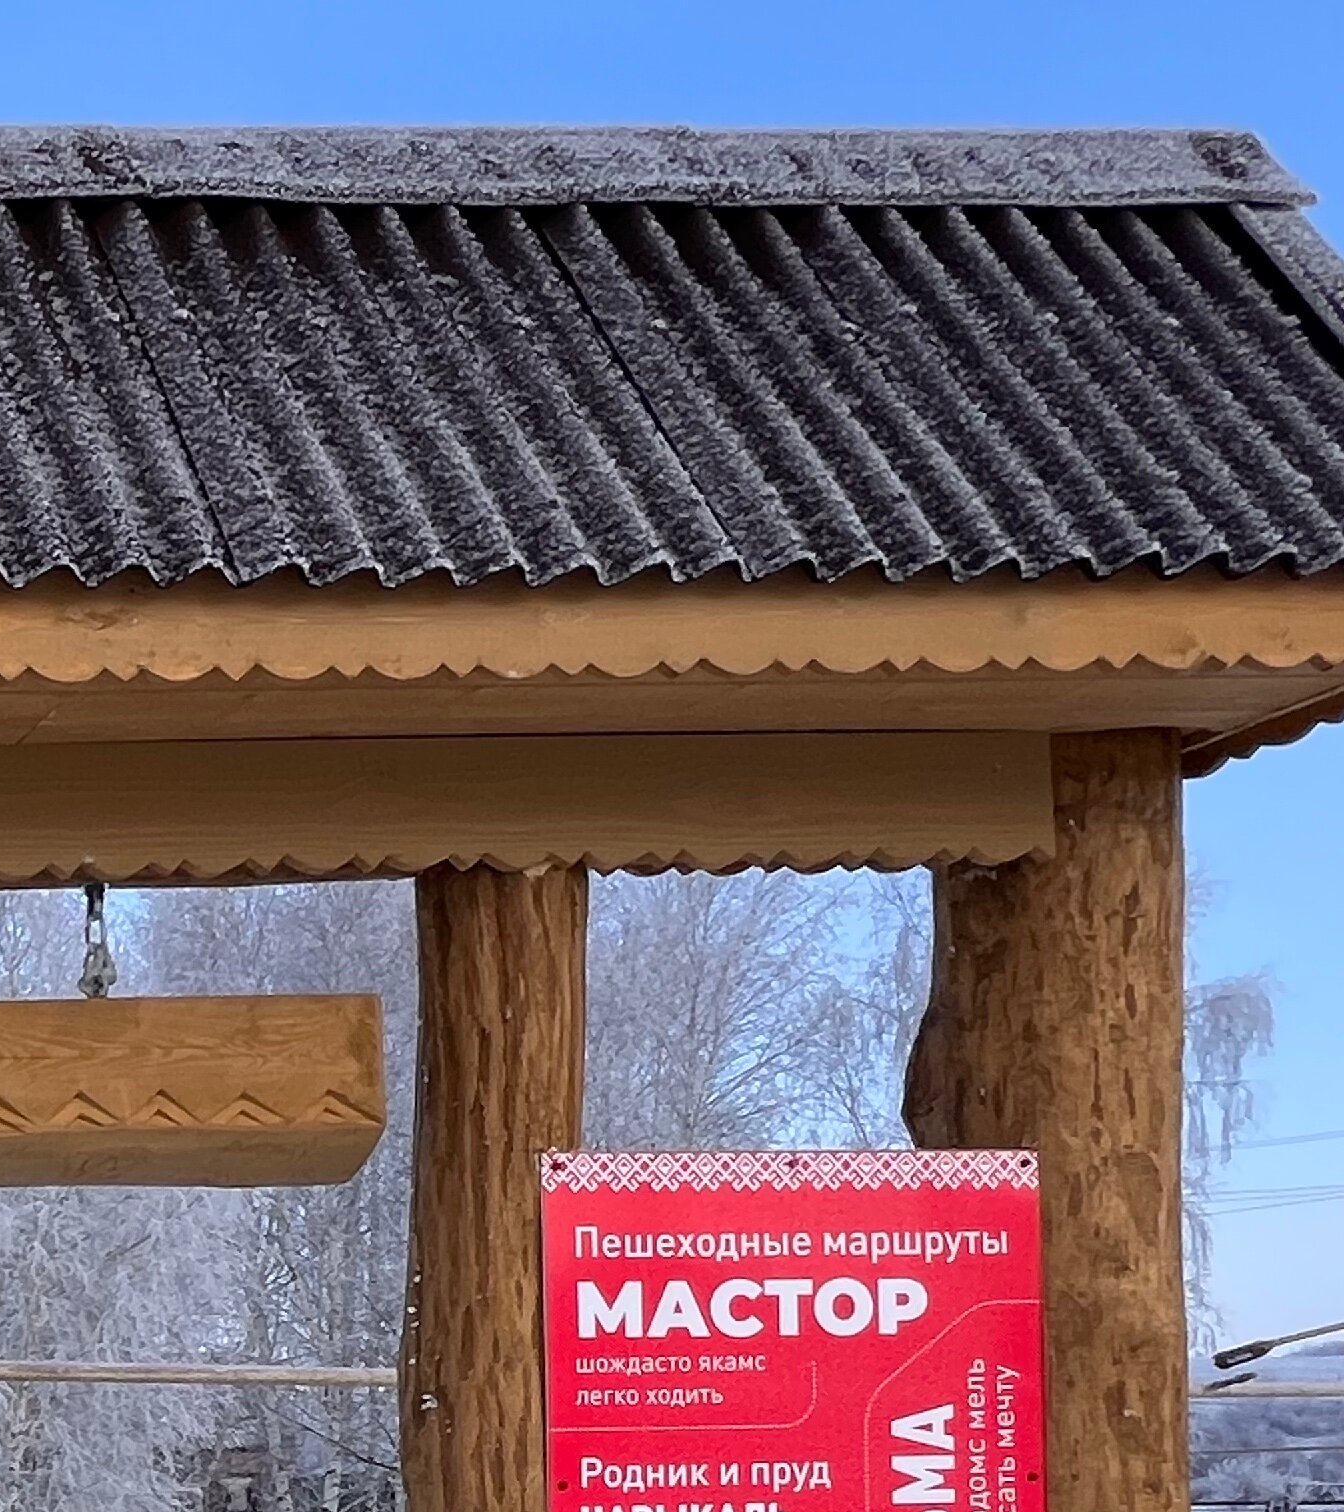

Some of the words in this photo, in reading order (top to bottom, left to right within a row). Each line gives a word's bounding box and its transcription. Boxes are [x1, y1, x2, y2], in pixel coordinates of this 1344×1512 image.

[576, 1226, 811, 1261] Пешеходные
[823, 1231, 1007, 1263] маршруты
[577, 1277, 927, 1338] МАСТОР
[576, 1357, 691, 1376] шождасто
[699, 1355, 765, 1371] якамс
[576, 1389, 639, 1405] легко
[647, 1389, 723, 1407] ходить
[967, 1359, 985, 1428] мель
[997, 1365, 1020, 1447] мечту
[581, 1457, 709, 1493] Родник
[721, 1463, 739, 1485] и
[752, 1462, 831, 1492] пруд
